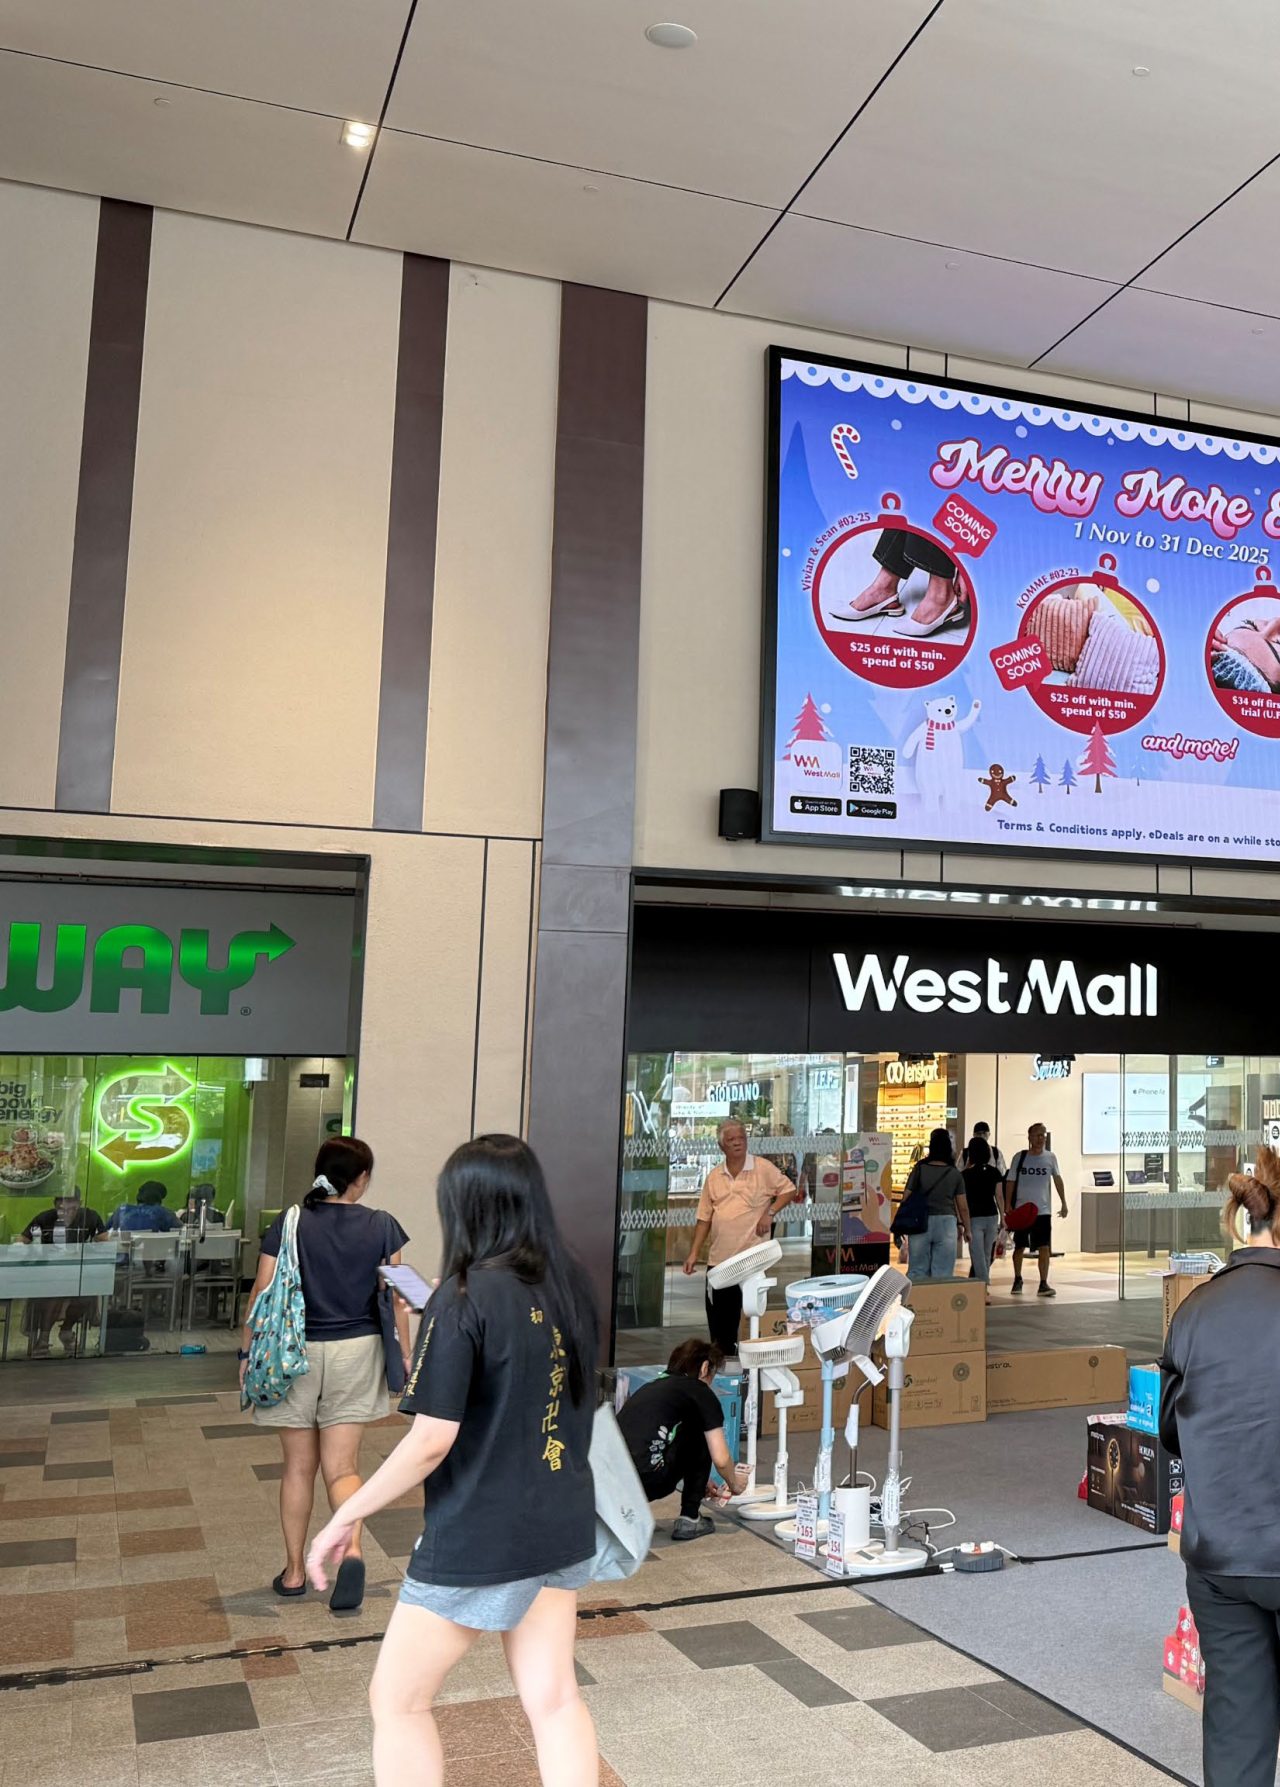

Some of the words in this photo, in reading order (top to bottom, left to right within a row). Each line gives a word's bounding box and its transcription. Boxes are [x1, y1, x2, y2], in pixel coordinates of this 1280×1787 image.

[930, 437, 1104, 517] Merry
[1115, 467, 1254, 540] More
[944, 516, 980, 547] SOON
[946, 501, 992, 540] COMING
[803, 557, 816, 591] Vivian
[810, 547, 819, 557] &
[816, 526, 839, 547] Sean
[838, 512, 871, 529] #02-25
[1073, 521, 1084, 540] 1
[1088, 523, 1131, 547] Nov
[1135, 531, 1155, 550] to
[1159, 534, 1180, 553] 31
[1186, 537, 1224, 559] Dec
[1228, 543, 1270, 566] 2025
[1017, 575, 1049, 609] KOMME
[1049, 567, 1080, 580] #02-23
[850, 641, 871, 653] $25
[874, 644, 891, 655] off
[893, 646, 918, 658] with
[921, 649, 946, 660] min.
[995, 643, 1042, 670] COMING
[862, 657, 897, 668] spend
[900, 658, 912, 669] of
[914, 660, 935, 671] $50
[1007, 658, 1042, 680] SOON
[1050, 692, 1069, 704] $25
[1072, 694, 1087, 705] off
[1089, 696, 1111, 708] with
[1114, 698, 1137, 710] min.
[1232, 695, 1249, 706] $34
[1251, 697, 1264, 708] off
[1061, 706, 1093, 718] spend
[1095, 708, 1107, 718] of
[1108, 709, 1127, 720] $50
[1241, 708, 1261, 718] trial
[1141, 733, 1184, 759] and
[1181, 736, 1240, 763] more!
[804, 769, 823, 777] West
[805, 804, 819, 812] App
[820, 804, 839, 813] Store
[861, 807, 882, 816] Google
[882, 808, 893, 817] Play
[998, 819, 1032, 832] Terms
[1036, 822, 1045, 832] &
[1049, 823, 1109, 837] Conditions
[1111, 828, 1147, 842] apply.
[1148, 830, 1184, 842] eDeals
[1187, 833, 1205, 843] are
[1208, 834, 1221, 844] on
[1223, 836, 1230, 845] a
[1233, 835, 1262, 846] while
[832, 953, 1012, 1014] West
[1016, 958, 1158, 1017] Mall
[1021, 1167, 1047, 1176] BOSS
